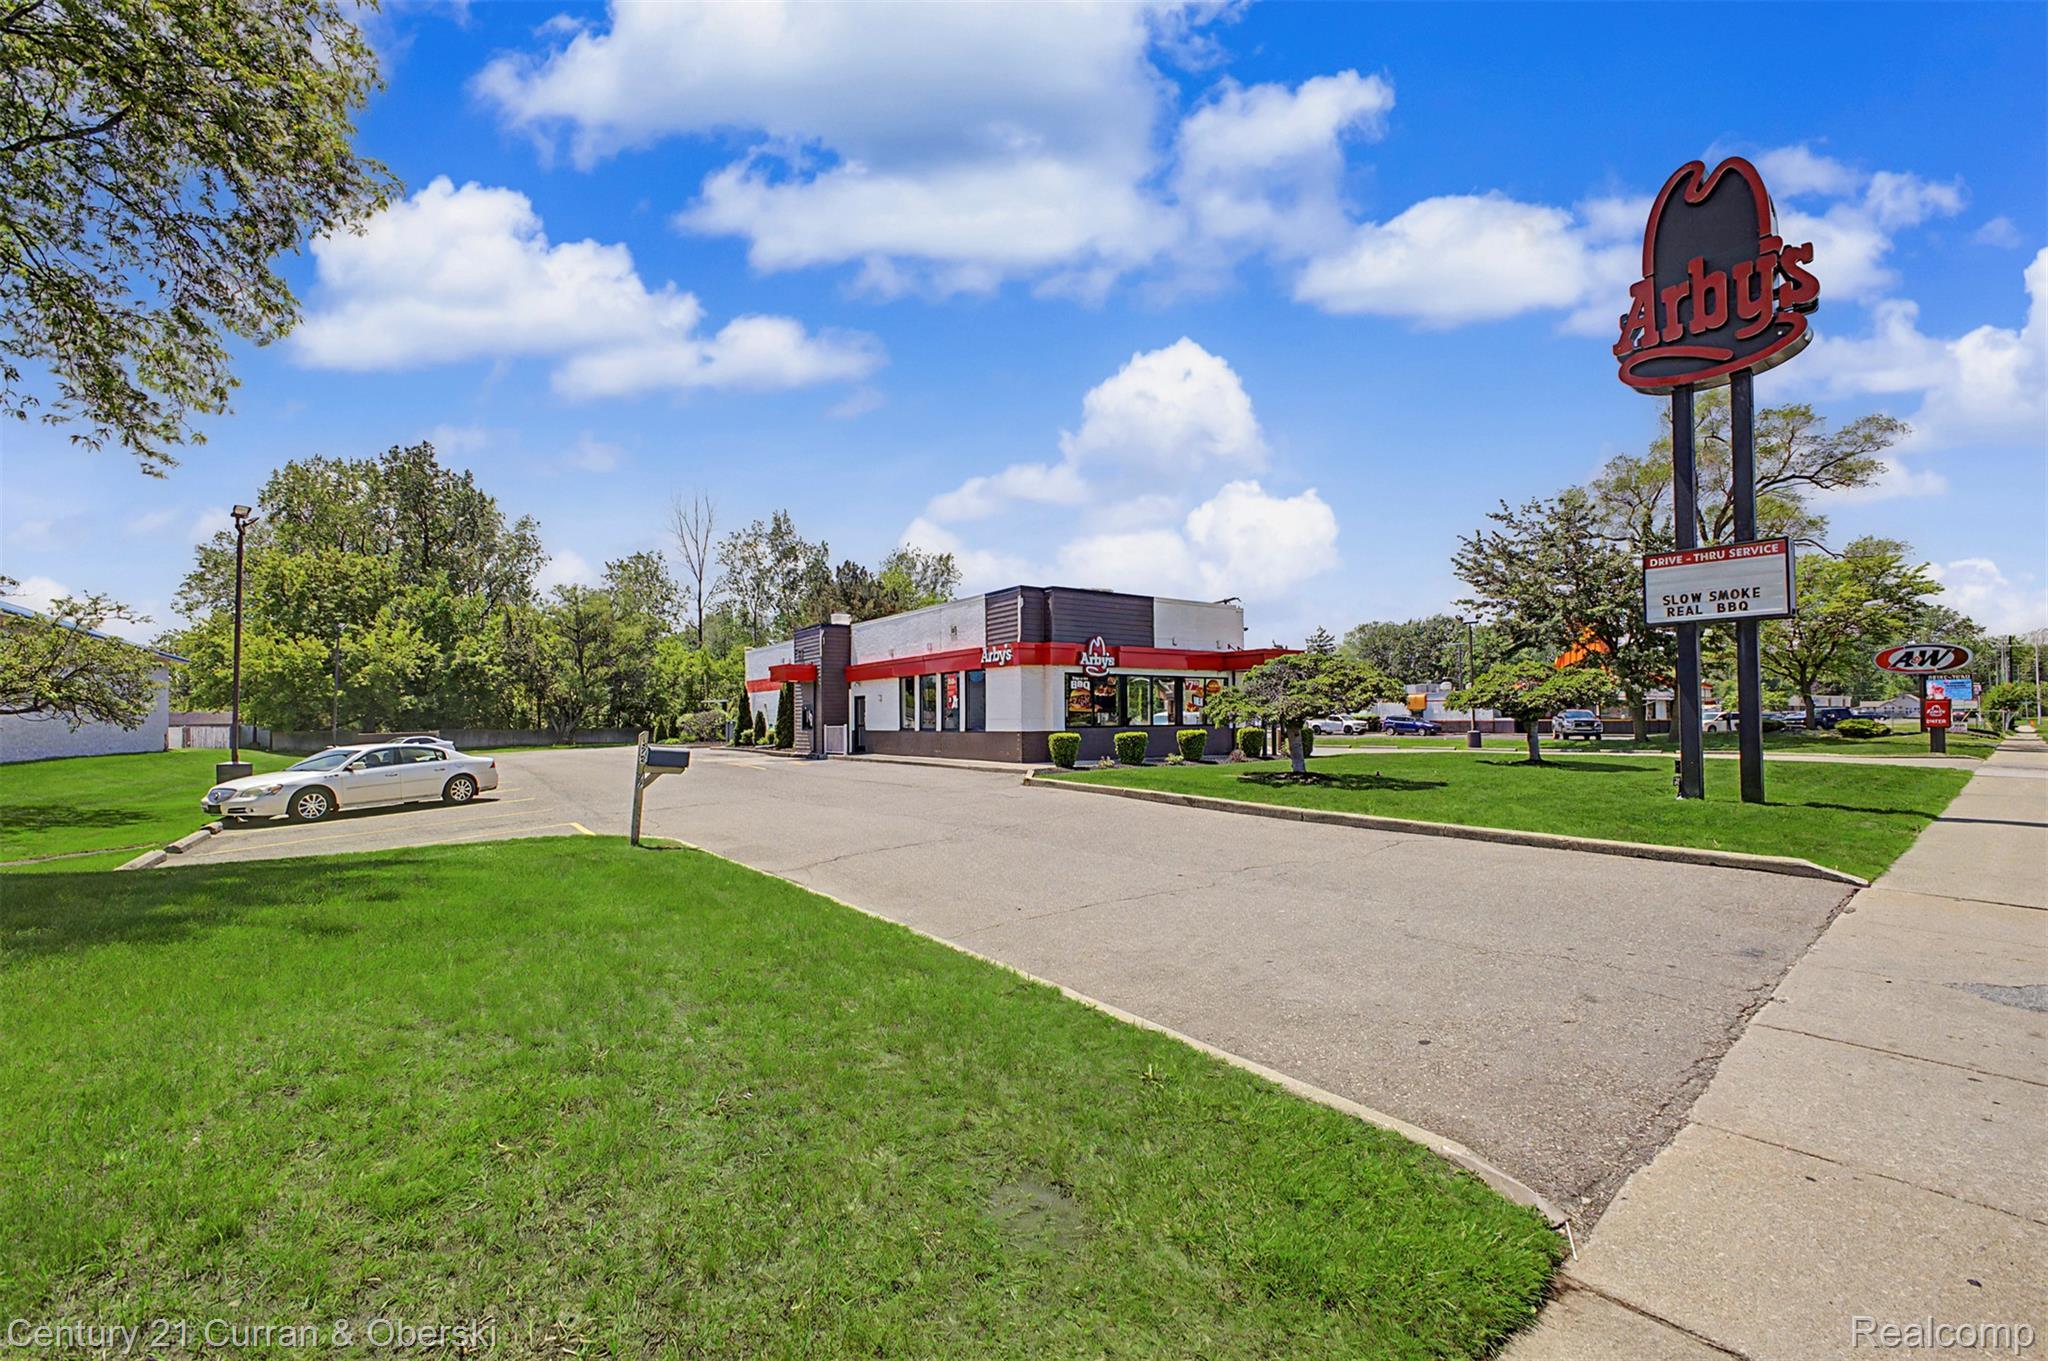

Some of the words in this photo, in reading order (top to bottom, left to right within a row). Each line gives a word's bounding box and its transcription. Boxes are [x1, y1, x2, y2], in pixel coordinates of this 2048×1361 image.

[1613, 236, 1820, 356] Arby's
[1650, 555, 1683, 567] DRIVE
[1693, 550, 1726, 563] THRU
[1729, 543, 1779, 558] SERVICE
[1663, 592, 1702, 606] SLOW
[1709, 587, 1761, 602] SMOKE
[1667, 605, 1703, 617] REAL
[1717, 601, 1749, 613] BBQ
[981, 644, 1013, 665] Arby's
[1080, 650, 1115, 668] Arby's
[1890, 648, 1955, 668] A&W
